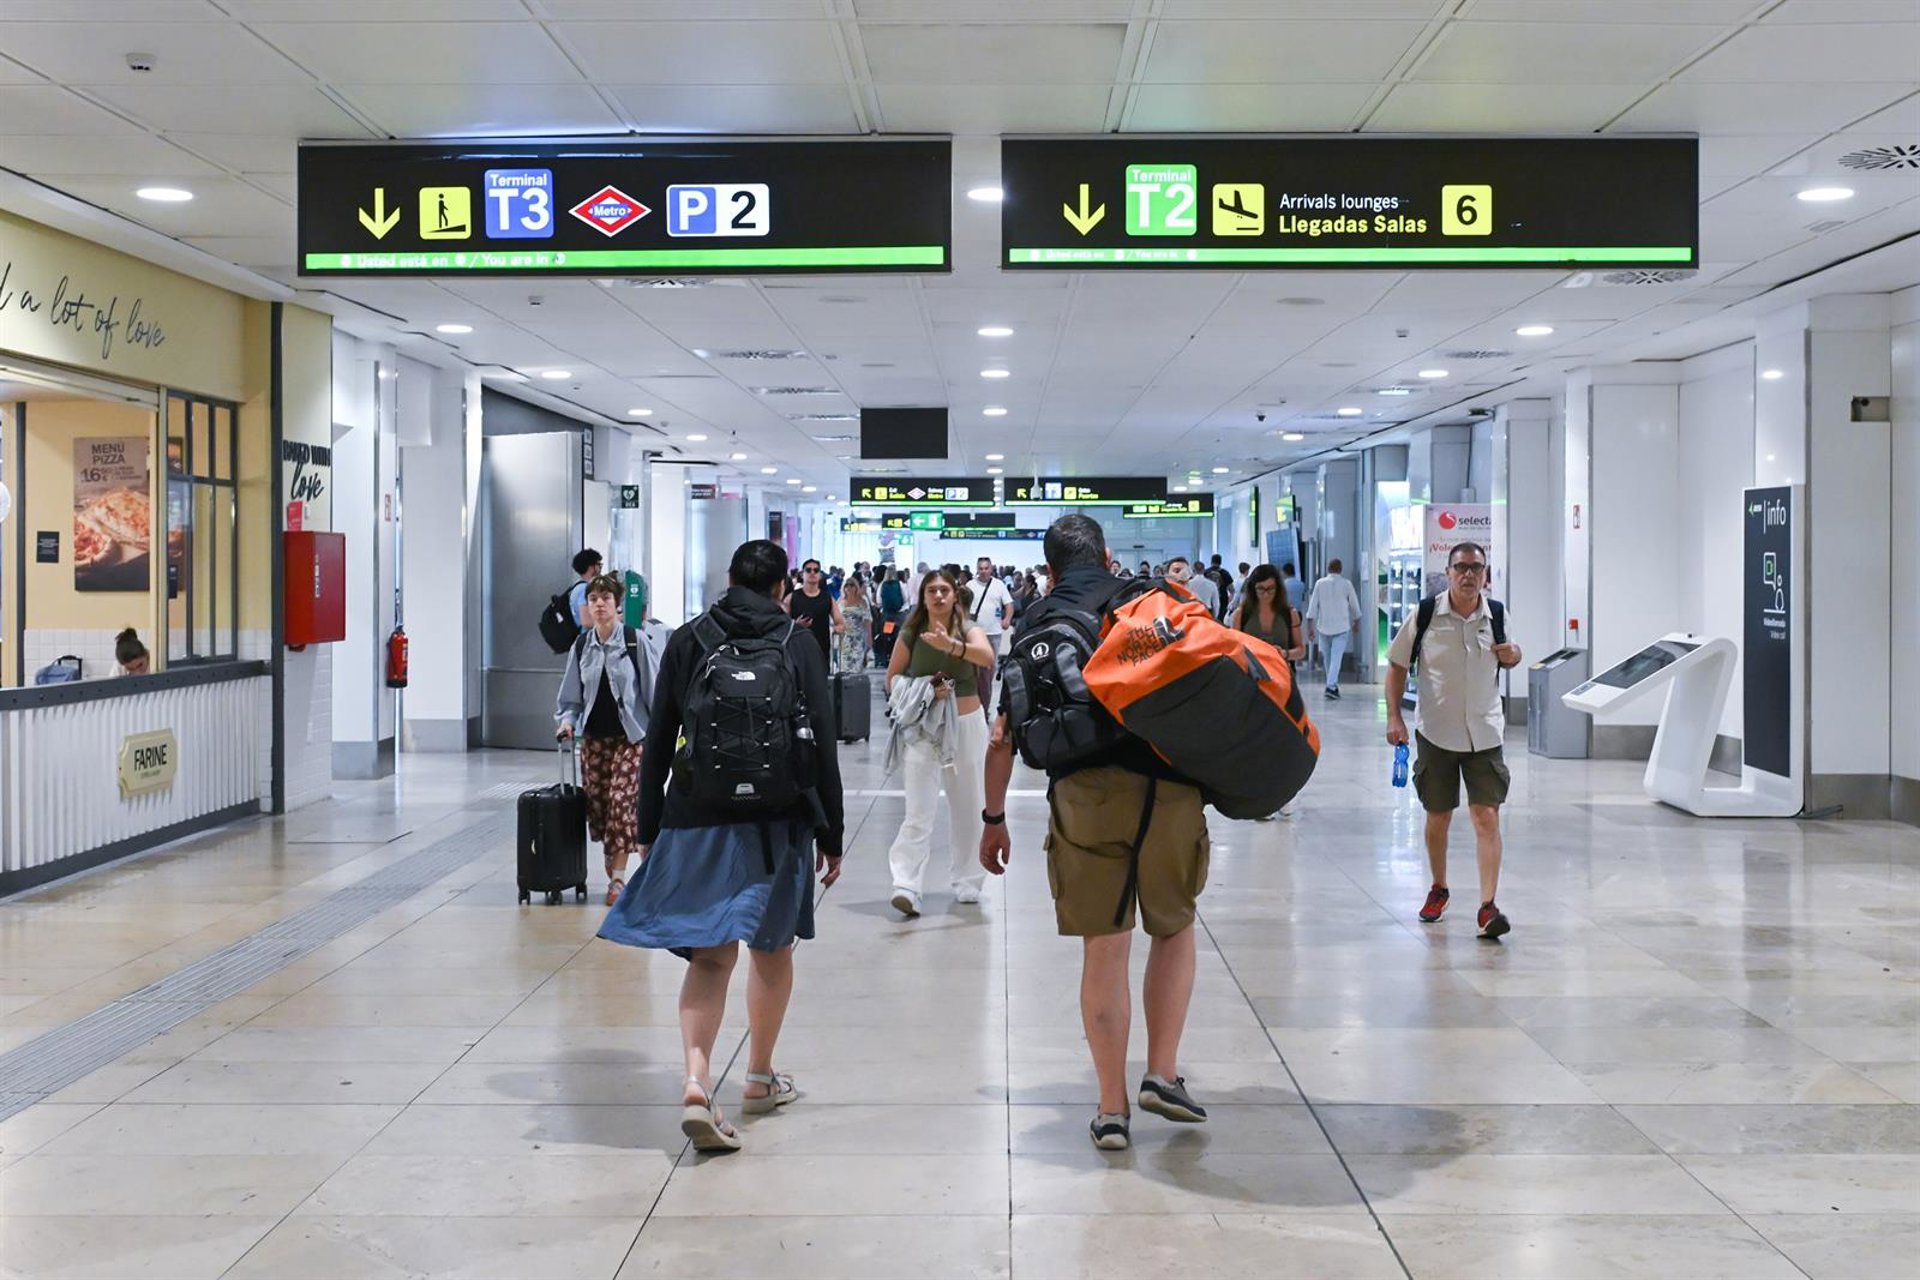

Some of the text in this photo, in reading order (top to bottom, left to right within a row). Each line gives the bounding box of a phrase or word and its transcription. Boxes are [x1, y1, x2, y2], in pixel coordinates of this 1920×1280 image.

[490, 173, 547, 187] Terminal
[1131, 168, 1192, 183] Terminal
[488, 187, 550, 231] T3
[593, 204, 626, 217] Metro
[678, 190, 757, 231] P 2
[1128, 183, 1195, 229] T2
[1279, 193, 1399, 212] Arrivals lounges
[1456, 195, 1478, 225] 6
[1279, 215, 1427, 236] Llegadas Salas
[483, 254, 508, 265] You
[21, 290, 41, 312] a
[51, 275, 94, 332] lot
[95, 297, 120, 360] of
[126, 298, 165, 348] love
[290, 462, 324, 502] love
[1767, 499, 1787, 526] info
[134, 744, 167, 771] FARINE
